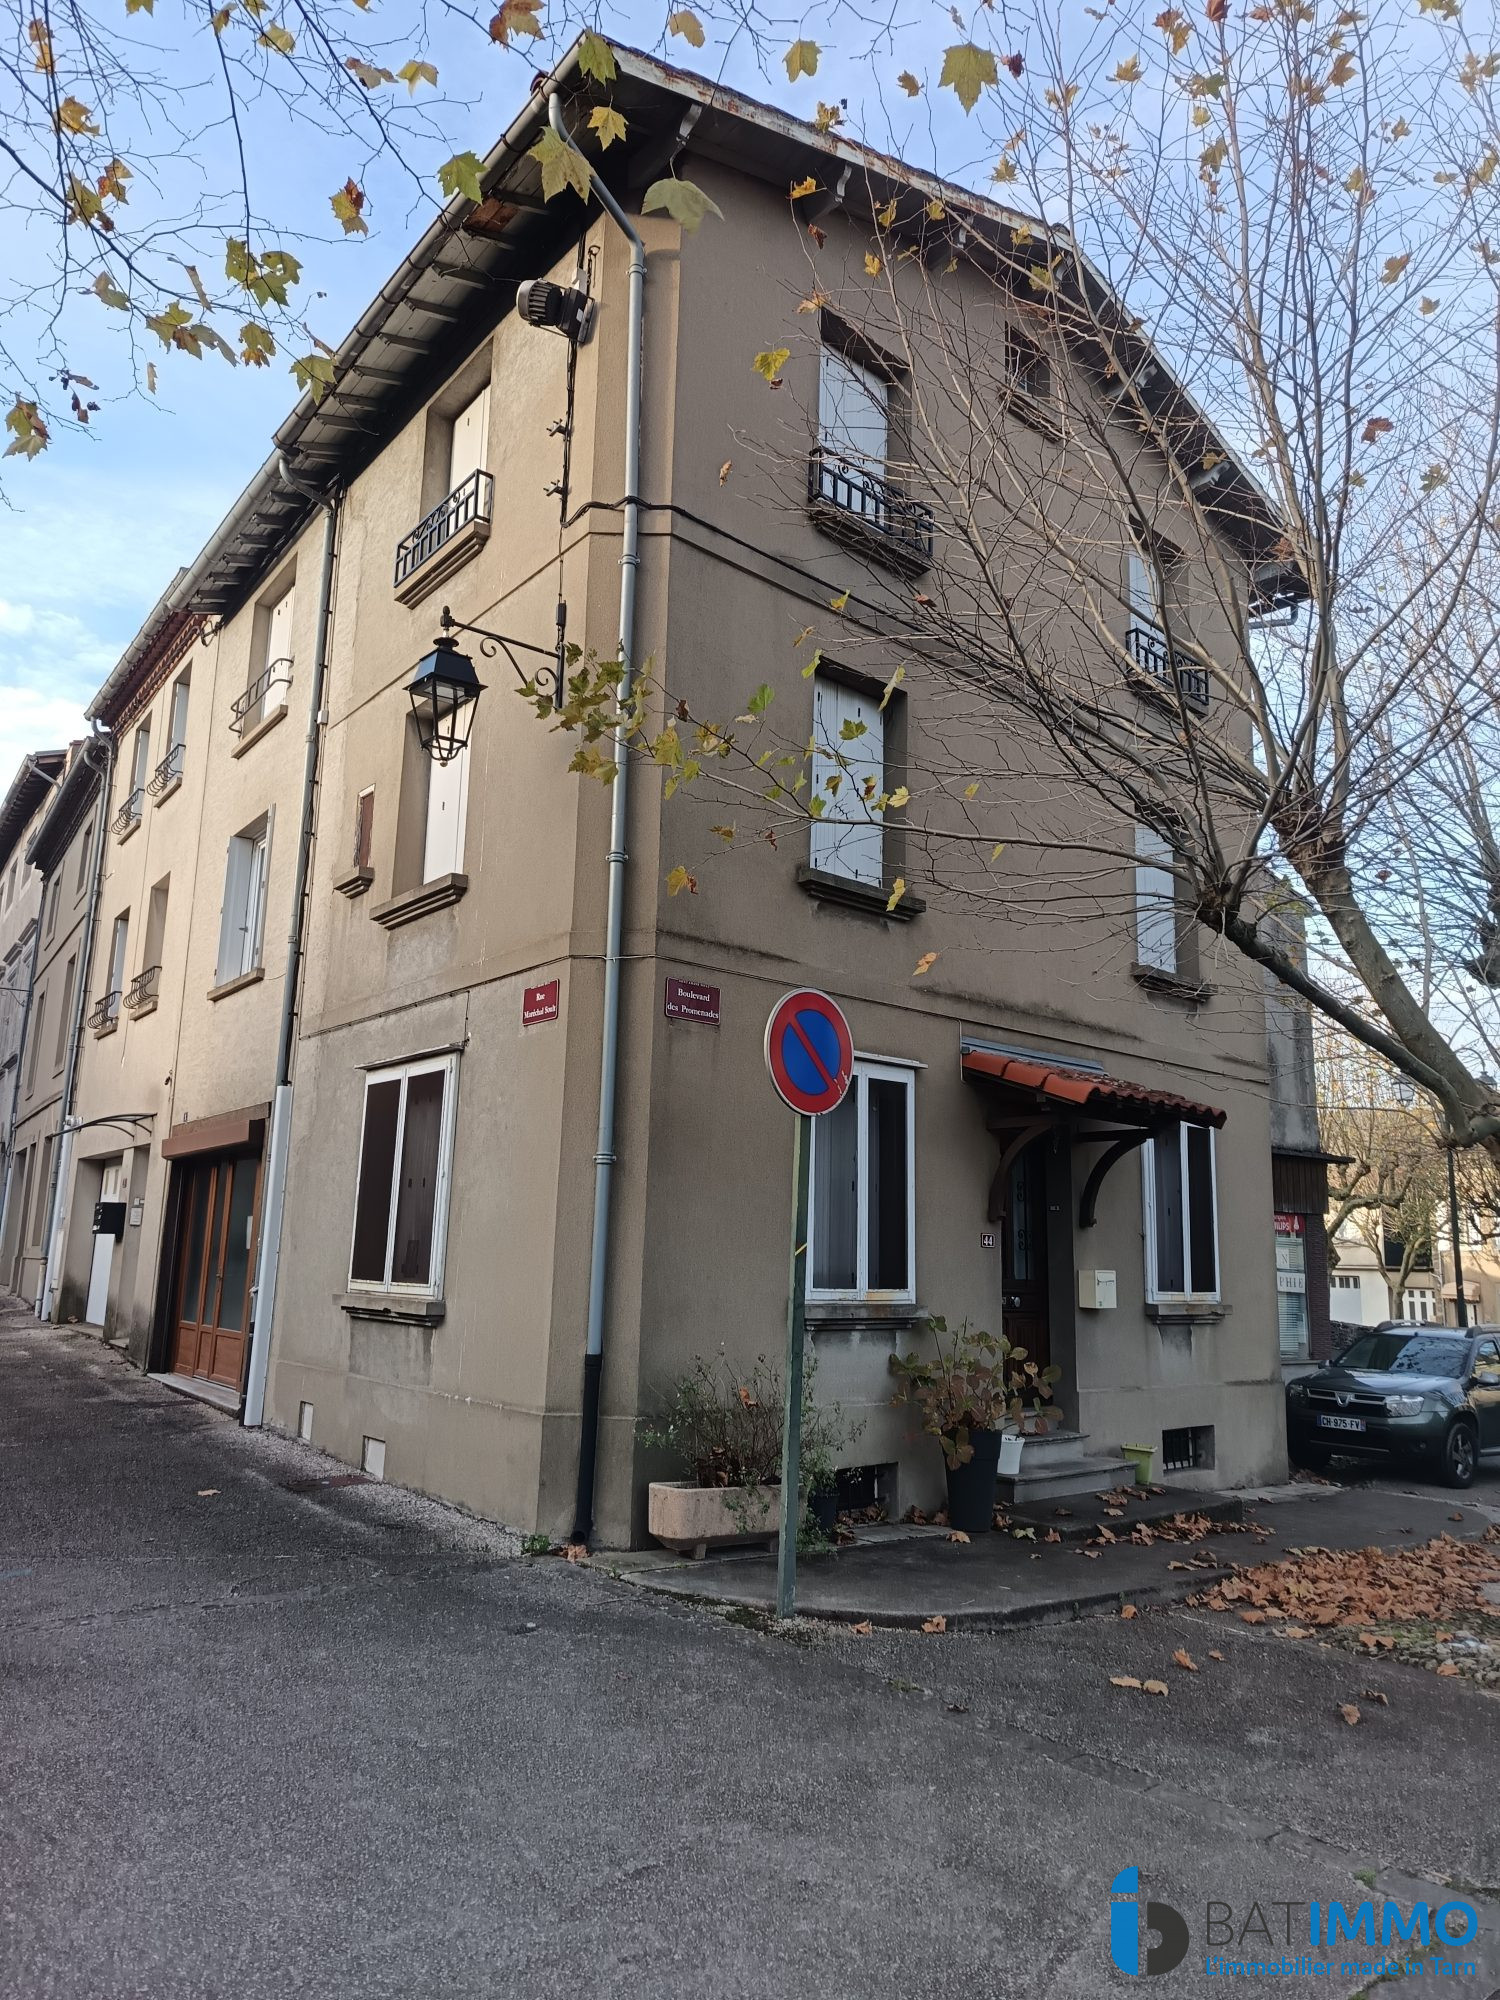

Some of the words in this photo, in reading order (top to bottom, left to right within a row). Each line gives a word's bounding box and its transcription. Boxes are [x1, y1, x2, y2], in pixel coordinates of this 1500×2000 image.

[536, 992, 546, 1001] Rue
[677, 988, 710, 1002] Boulevard
[667, 1002, 679, 1011] des
[681, 1004, 719, 1019] Promenades
[983, 1235, 993, 1246] 44
